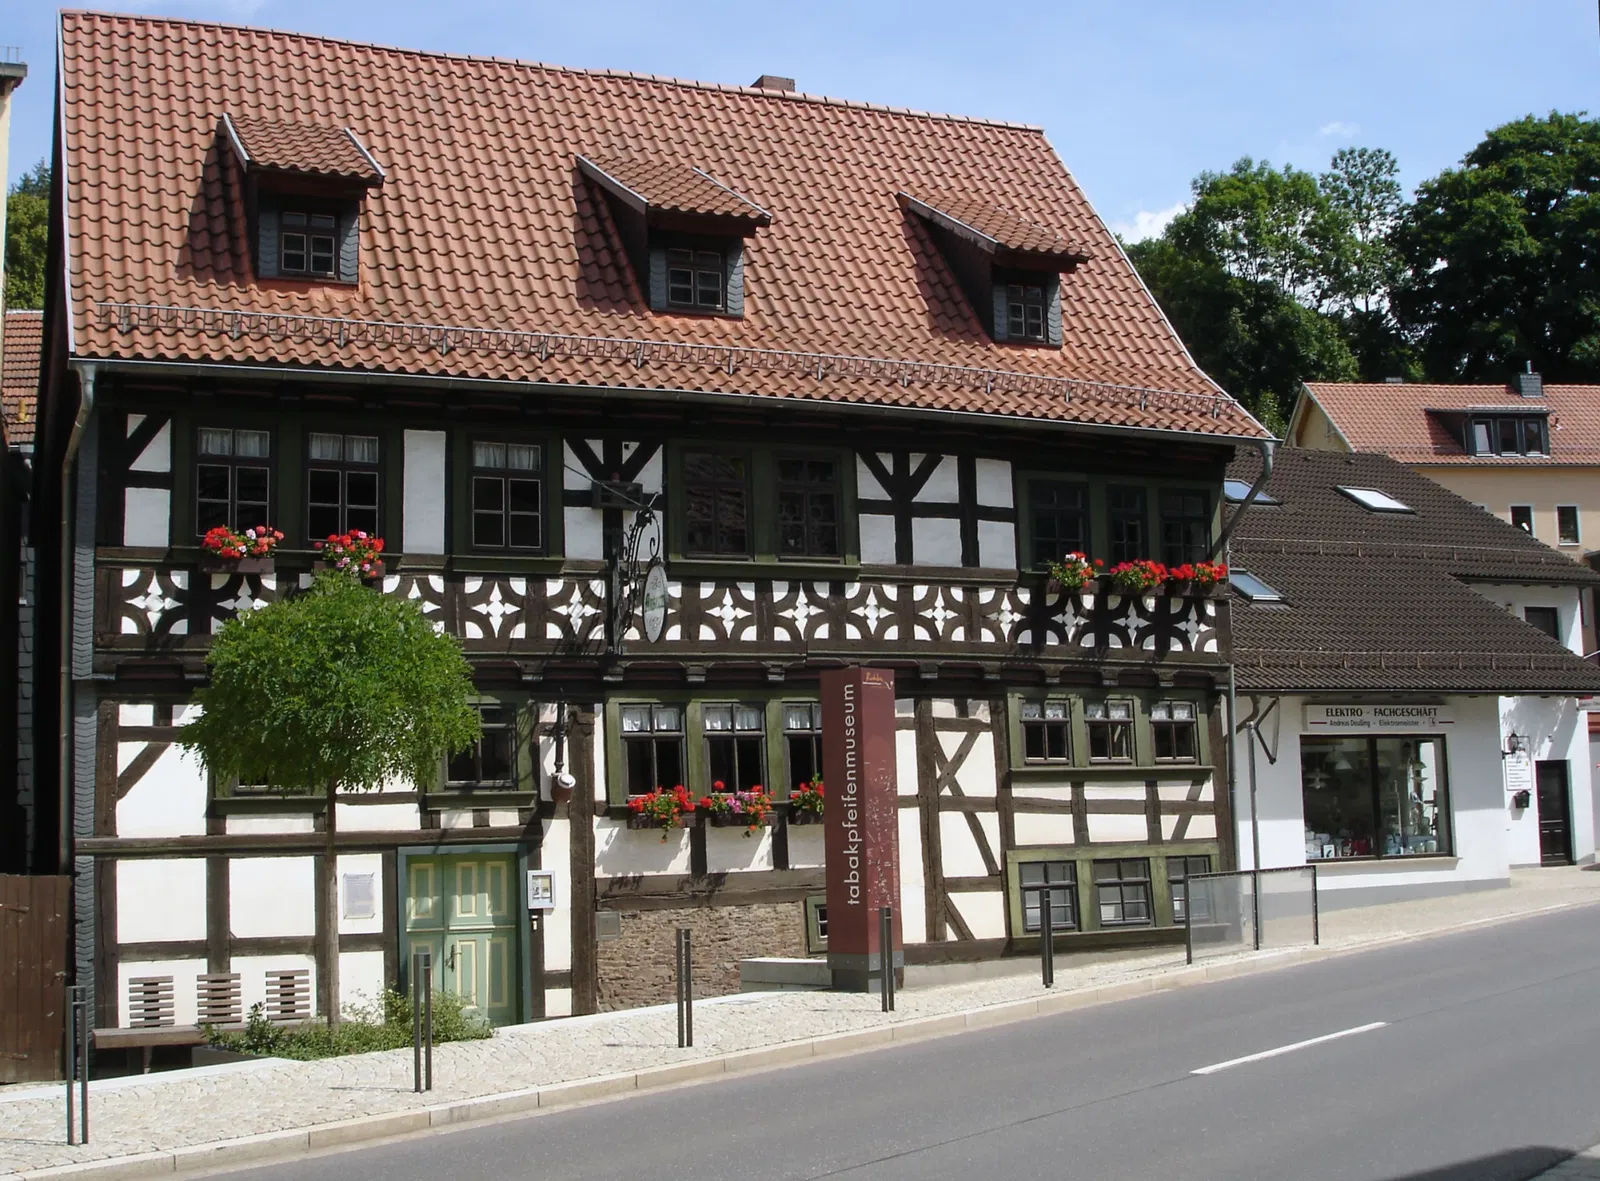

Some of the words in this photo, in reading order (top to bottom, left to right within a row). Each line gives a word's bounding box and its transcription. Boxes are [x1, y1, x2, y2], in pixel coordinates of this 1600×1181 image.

[1325, 707, 1363, 717] ELEKTRO
[1373, 706, 1438, 717] FACHGESCHÄFT
[1378, 718, 1419, 727] Elektromeister
[841, 684, 863, 905] tabakpfeifenmuseum
